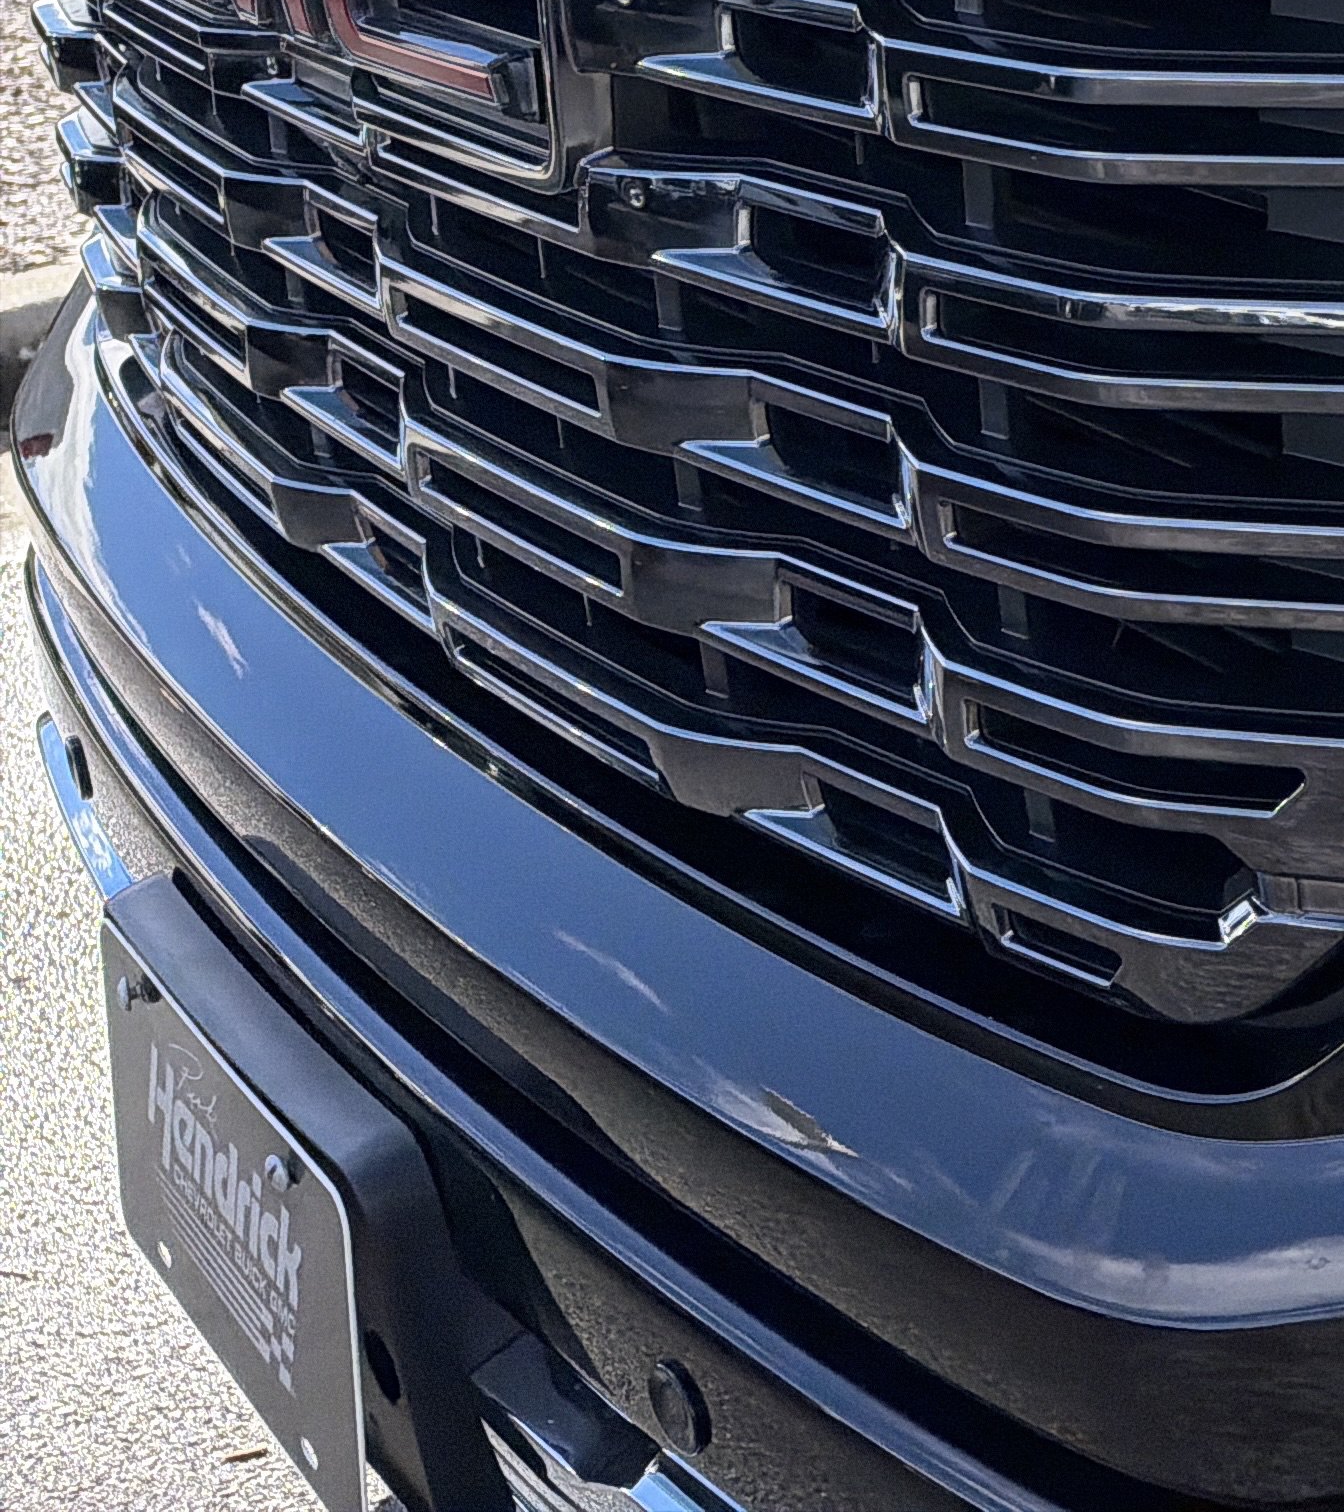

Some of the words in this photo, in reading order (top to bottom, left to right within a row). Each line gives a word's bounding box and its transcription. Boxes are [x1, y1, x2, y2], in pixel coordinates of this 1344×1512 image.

[148, 1041, 302, 1312] Hendrick
[173, 1163, 233, 1252] CHEVROLET
[233, 1244, 268, 1300] BUICK
[269, 1291, 296, 1339] GMC
